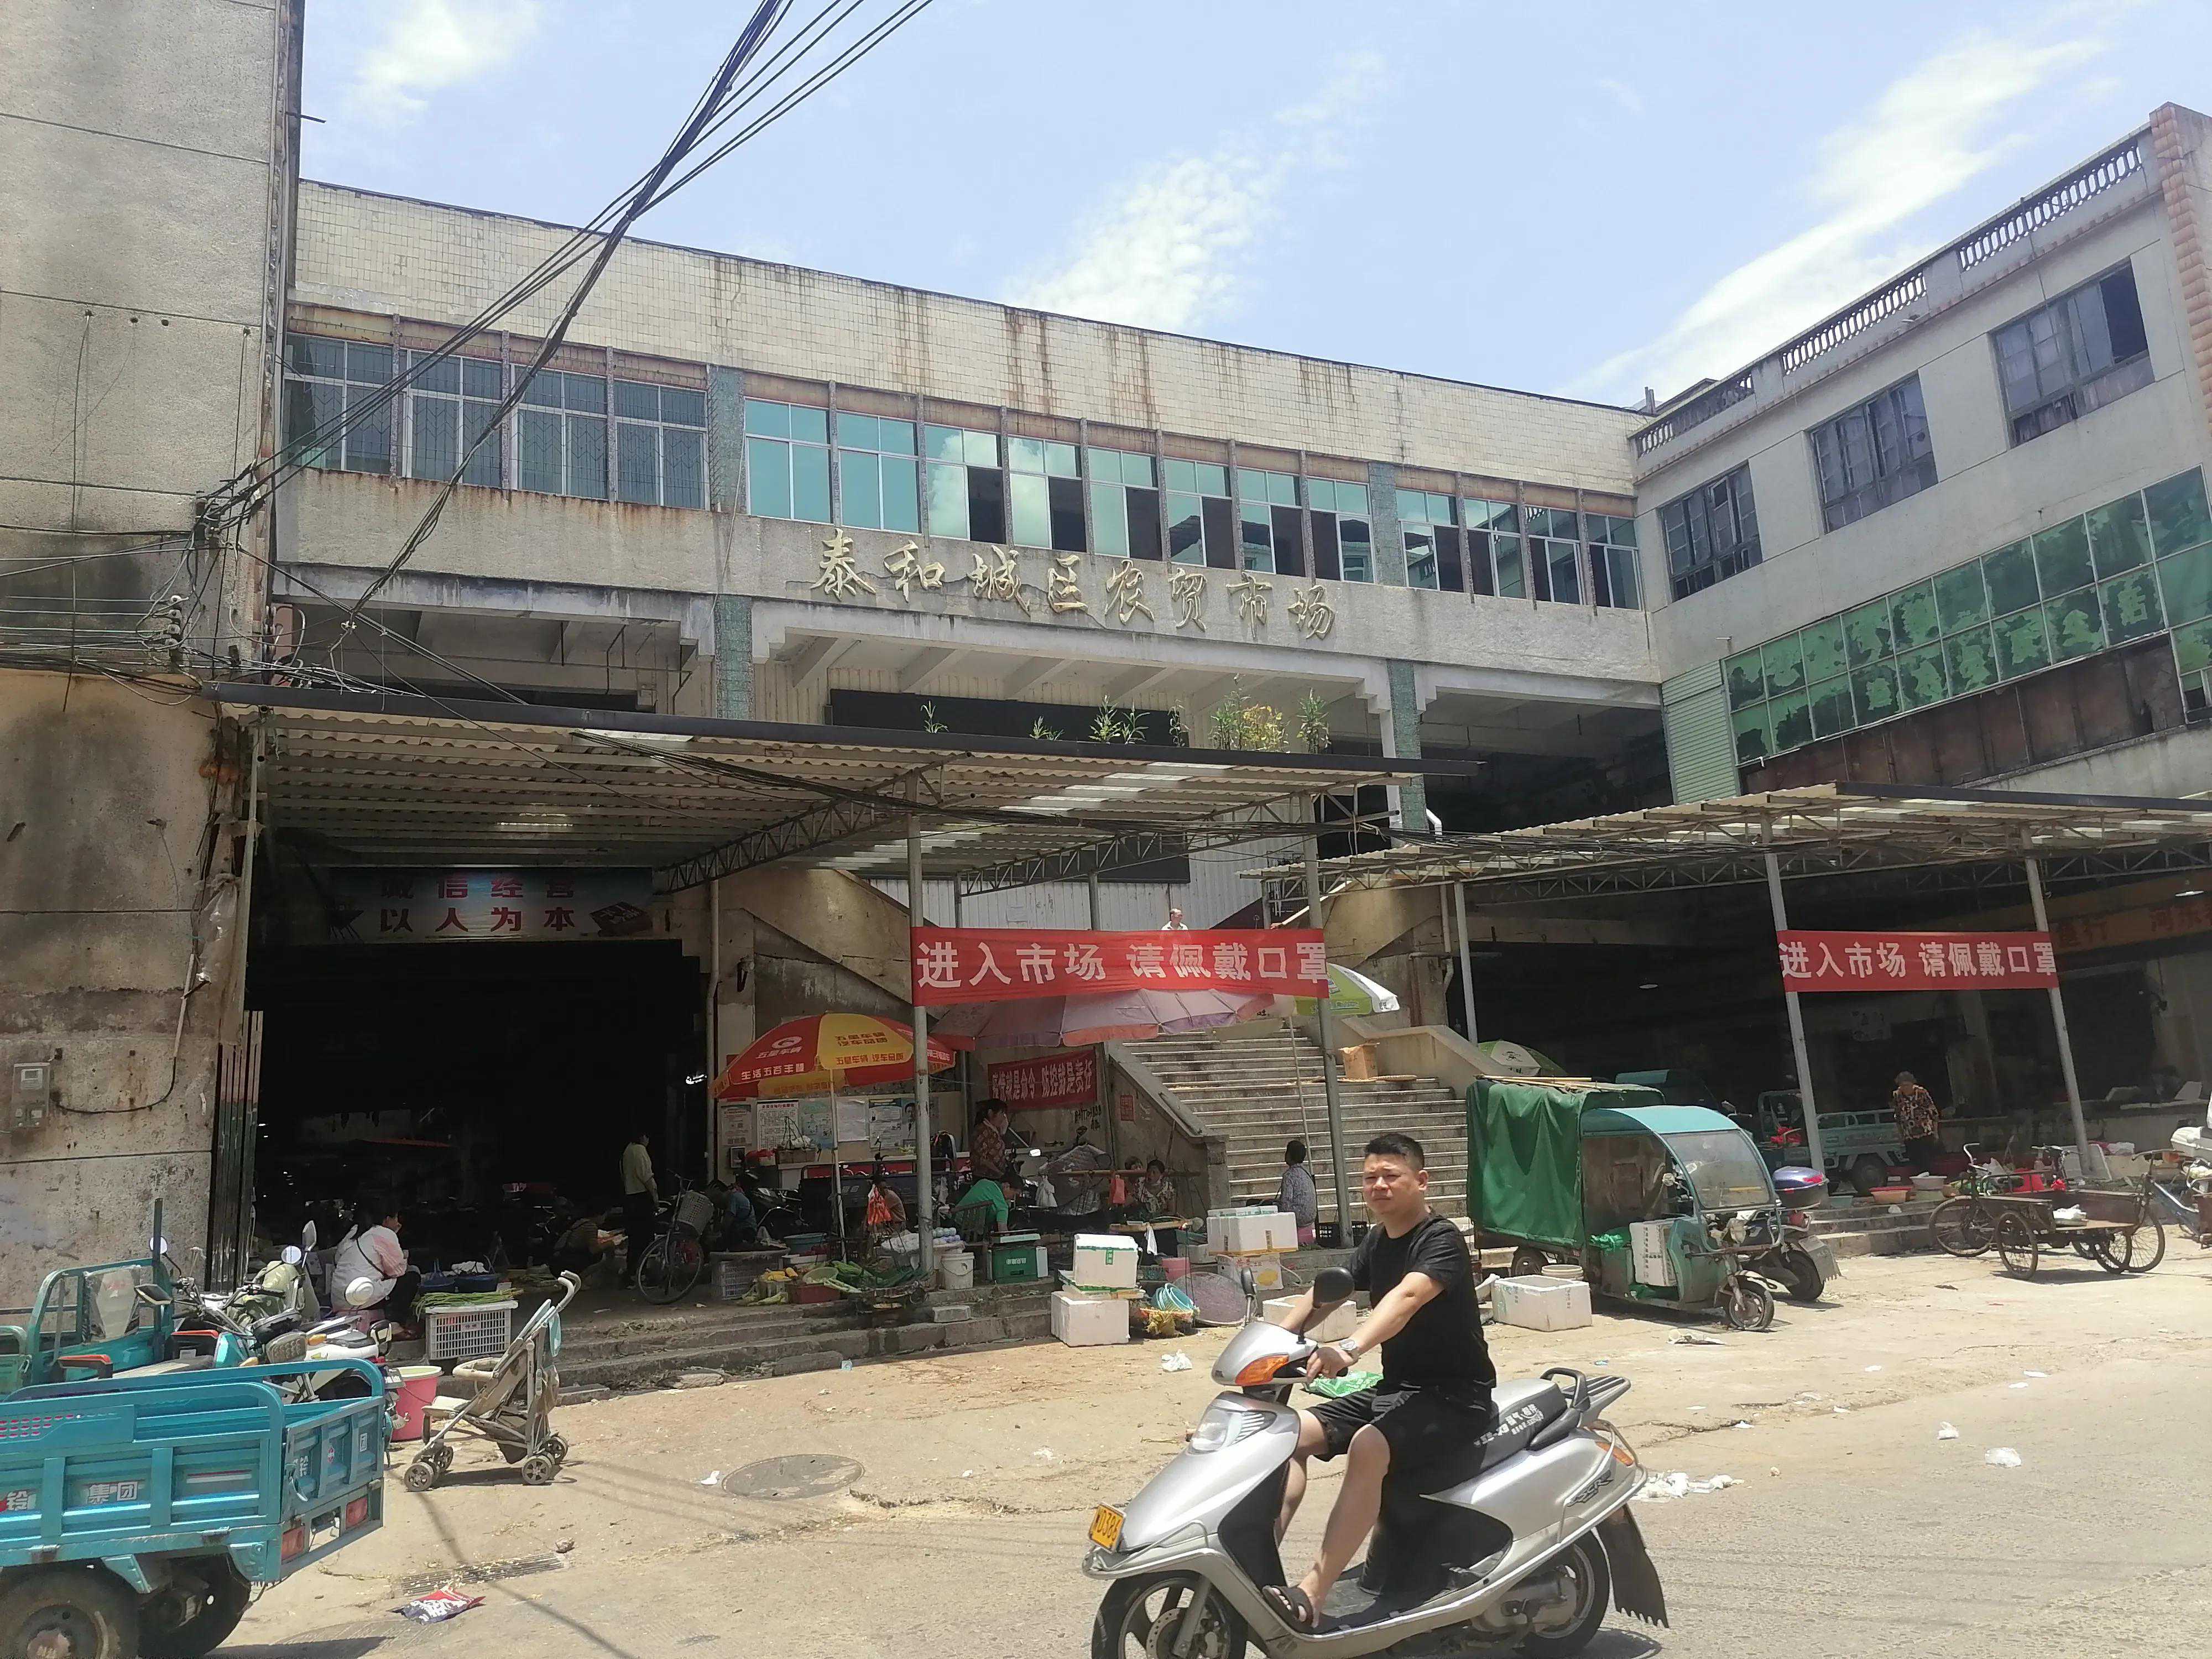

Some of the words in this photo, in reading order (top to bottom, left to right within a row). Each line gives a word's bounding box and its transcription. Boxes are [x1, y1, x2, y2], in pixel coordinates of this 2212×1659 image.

[811, 528, 1340, 640] 泰和城区农贸市场
[380, 906, 575, 933] 以人为本
[917, 941, 1107, 988] 进入市场
[1126, 942, 1328, 983] 请佩戴口罩
[1778, 941, 1906, 978] 进入市场
[1918, 941, 2057, 978] 请佩戴口罩
[1041, 1058, 1093, 1098] 防控就是责任
[87, 1481, 138, 1505] 集团
